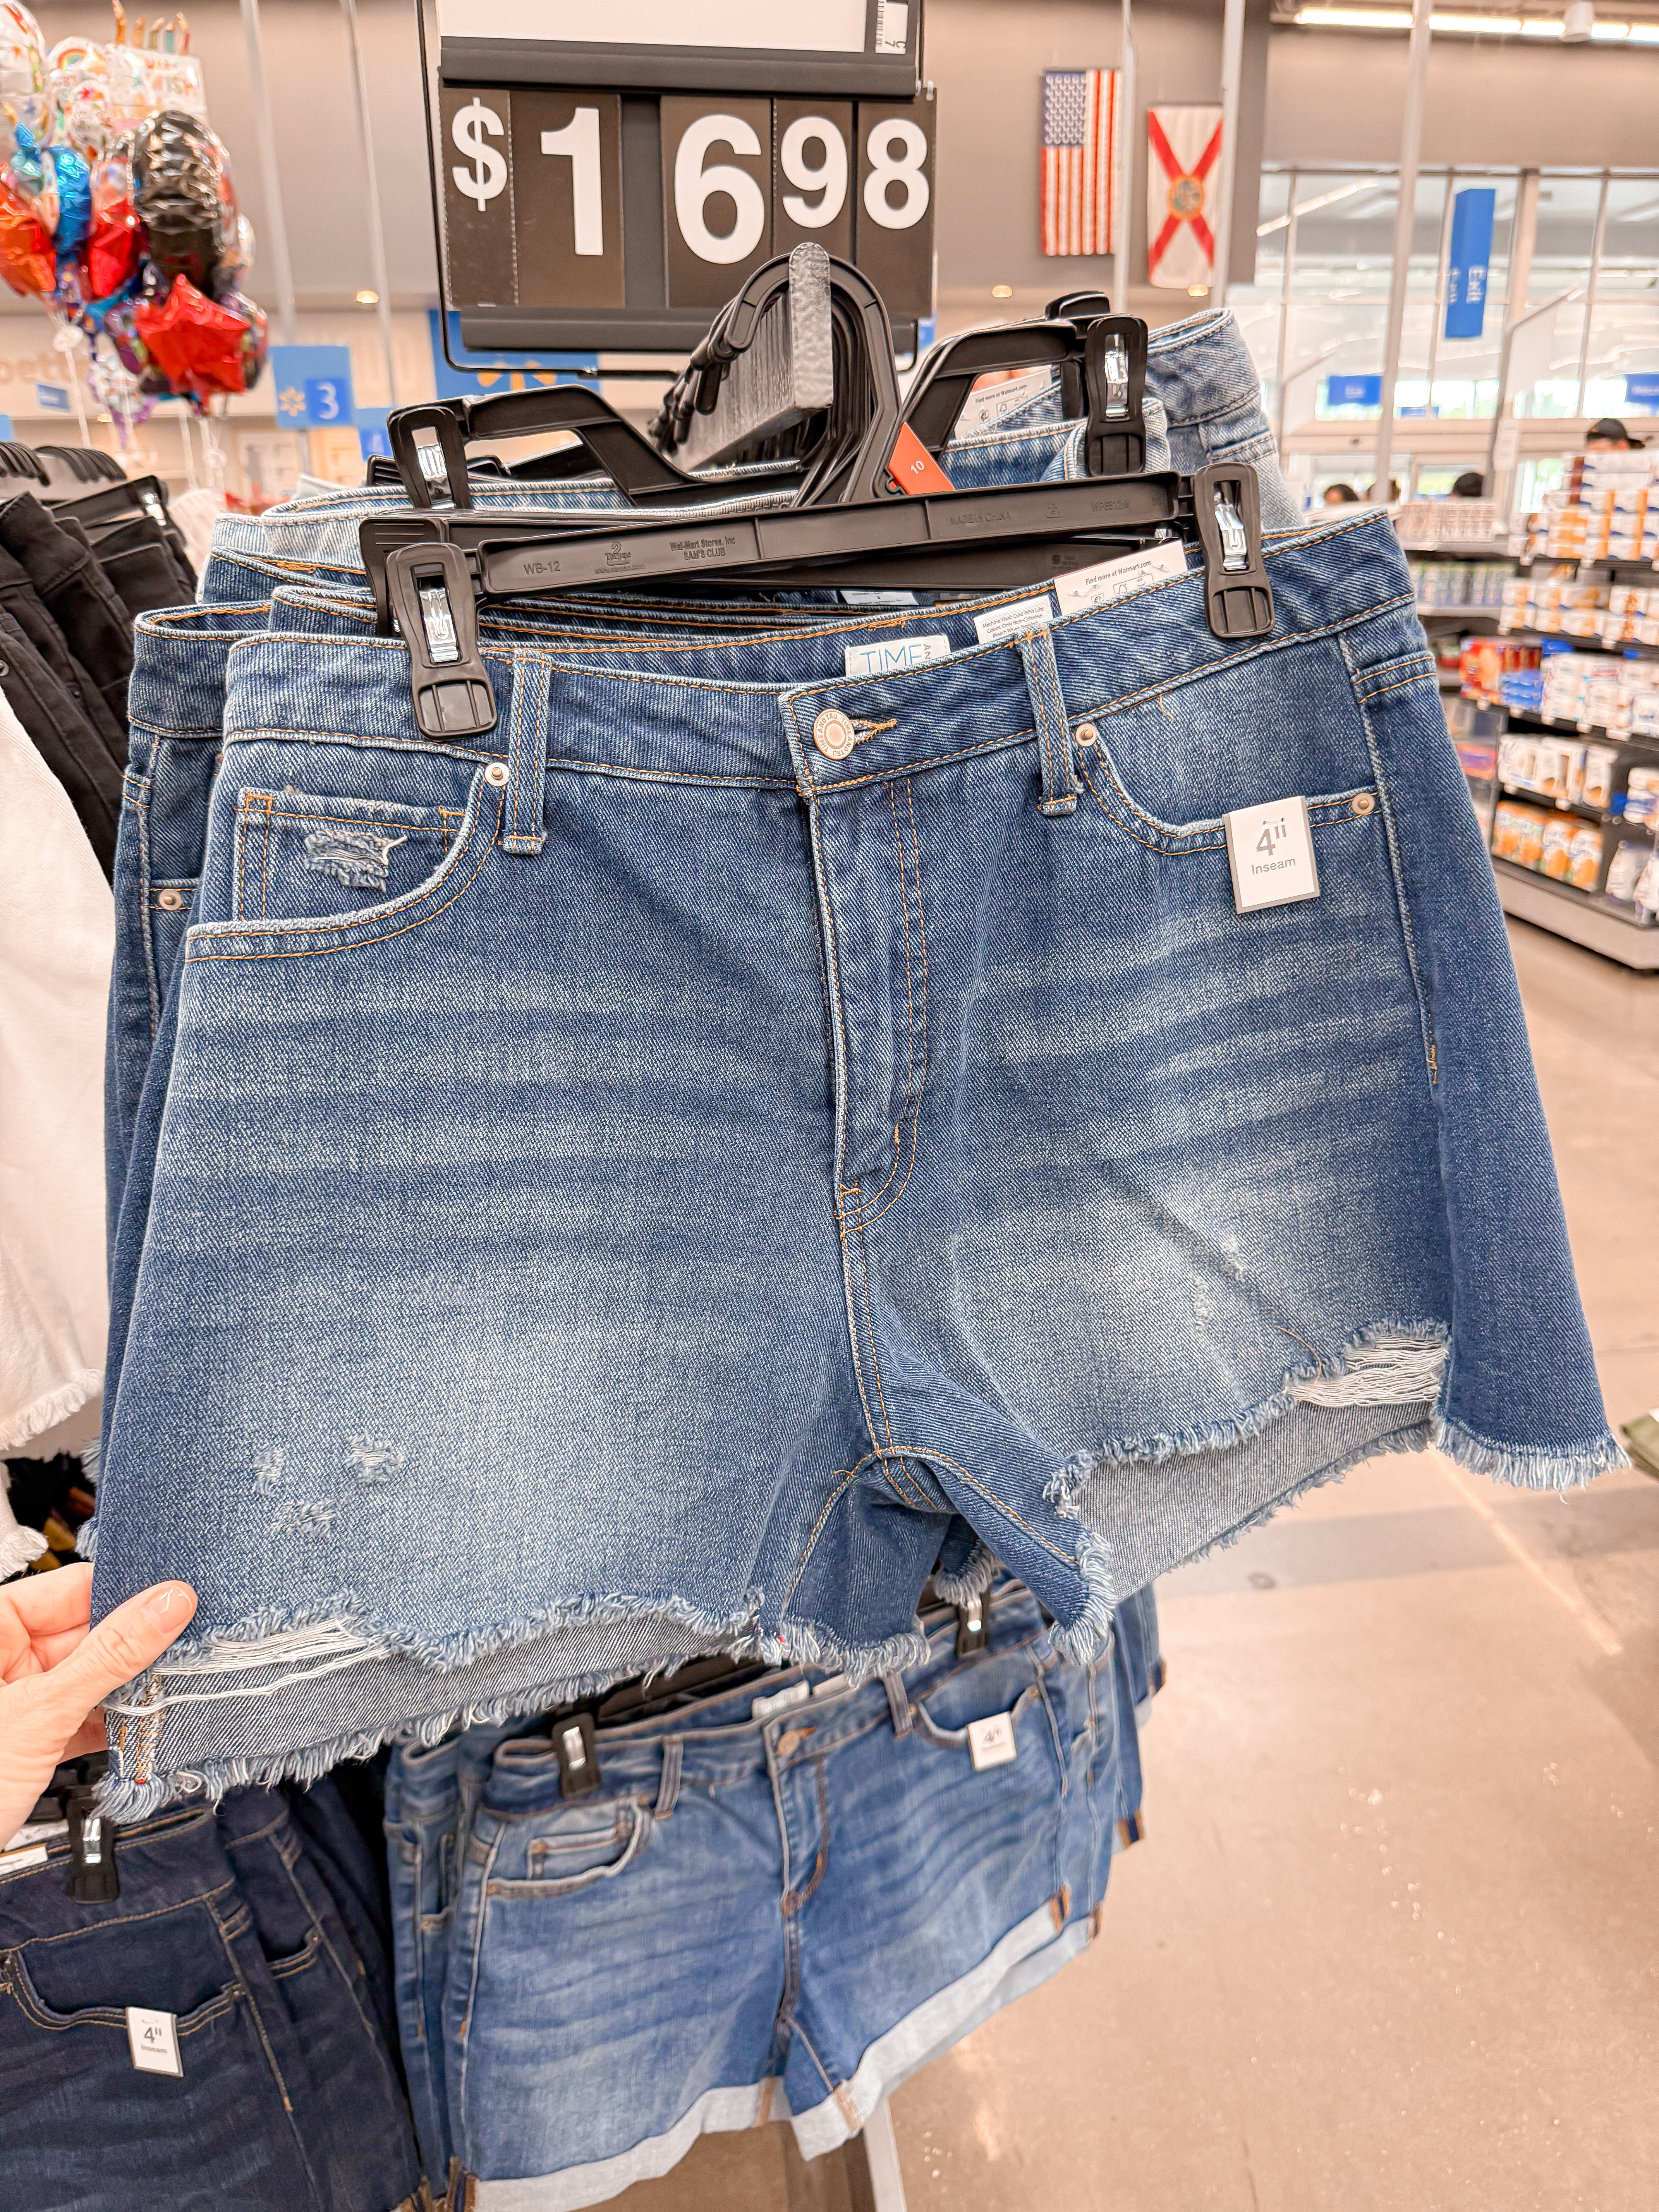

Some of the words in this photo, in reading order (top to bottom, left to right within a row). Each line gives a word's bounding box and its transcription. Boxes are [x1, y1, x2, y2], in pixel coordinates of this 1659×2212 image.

[318, 381, 340, 420] 3
[910, 460, 924, 474] 10
[950, 514, 974, 525] MADE
[986, 512, 1011, 521] CHINA
[670, 540, 700, 551] Wal-Mart
[684, 549, 705, 560] SAM'S
[706, 547, 725, 557] CLUB
[523, 561, 561, 575] WB-12
[1085, 577, 1097, 585] Find
[1097, 574, 1111, 582] more
[1118, 560, 1151, 575] Walmart.com
[982, 619, 1001, 629] Machine
[1013, 613, 1043, 625] Non-Chlorine
[817, 717, 827, 733] AND
[818, 734, 829, 752] TIME
[1256, 824, 1287, 856] 4"
[1251, 858, 1296, 875] Inseam
[144, 2027, 162, 2043] 4"
